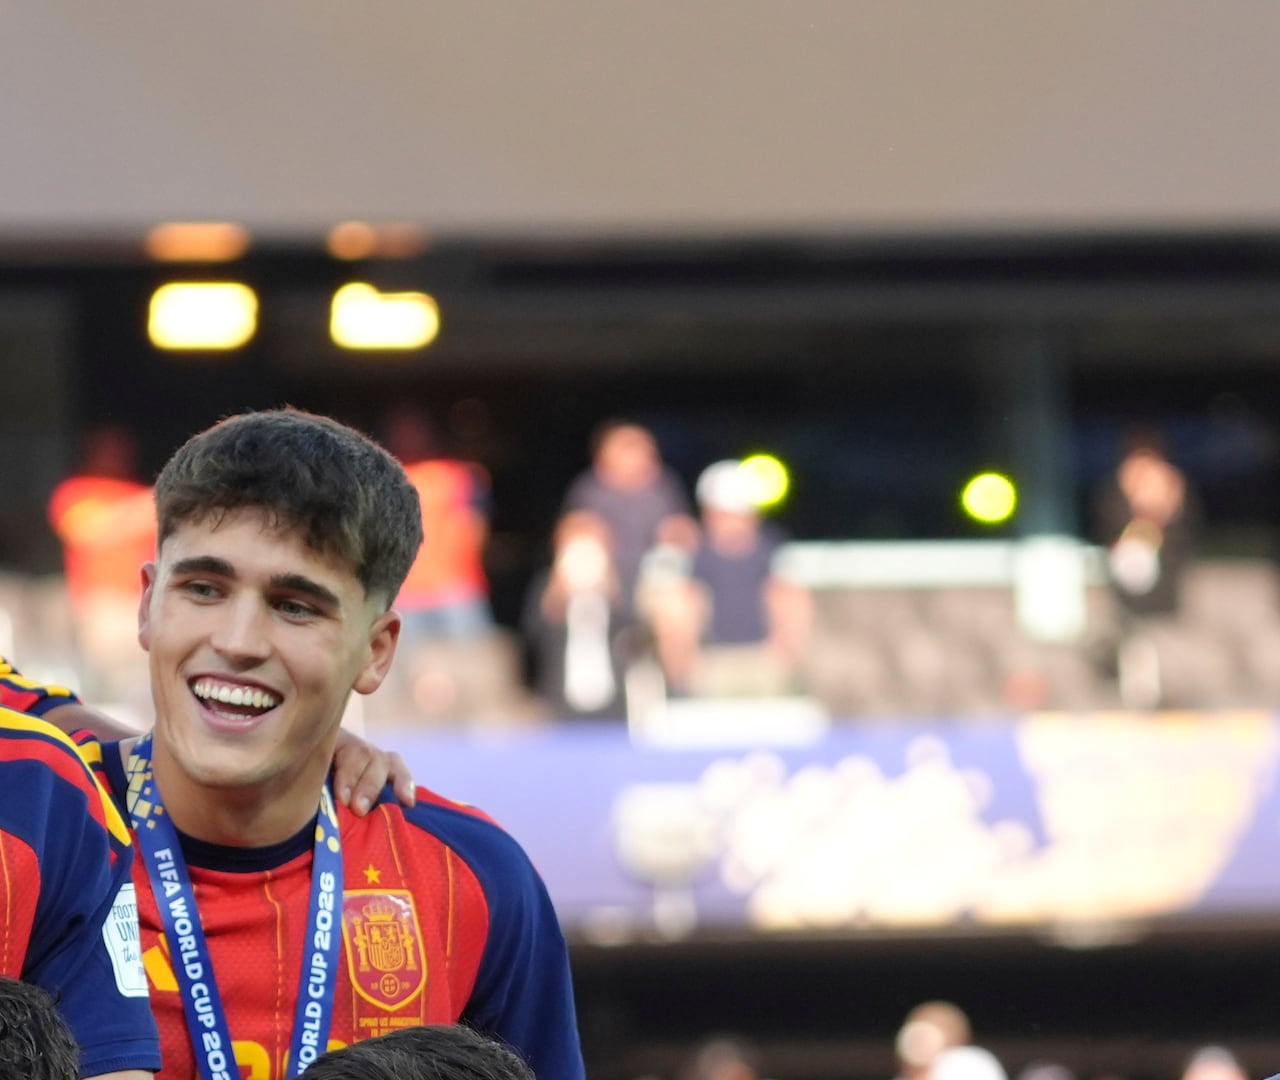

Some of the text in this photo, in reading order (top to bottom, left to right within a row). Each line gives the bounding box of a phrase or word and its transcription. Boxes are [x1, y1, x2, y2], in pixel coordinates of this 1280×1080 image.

[112, 903, 136, 920] FOOT
[154, 848, 182, 898] FIFA
[169, 898, 204, 980] WORLD
[190, 981, 216, 1029] CUP
[314, 872, 335, 951] 2026
[308, 953, 329, 999] CUP
